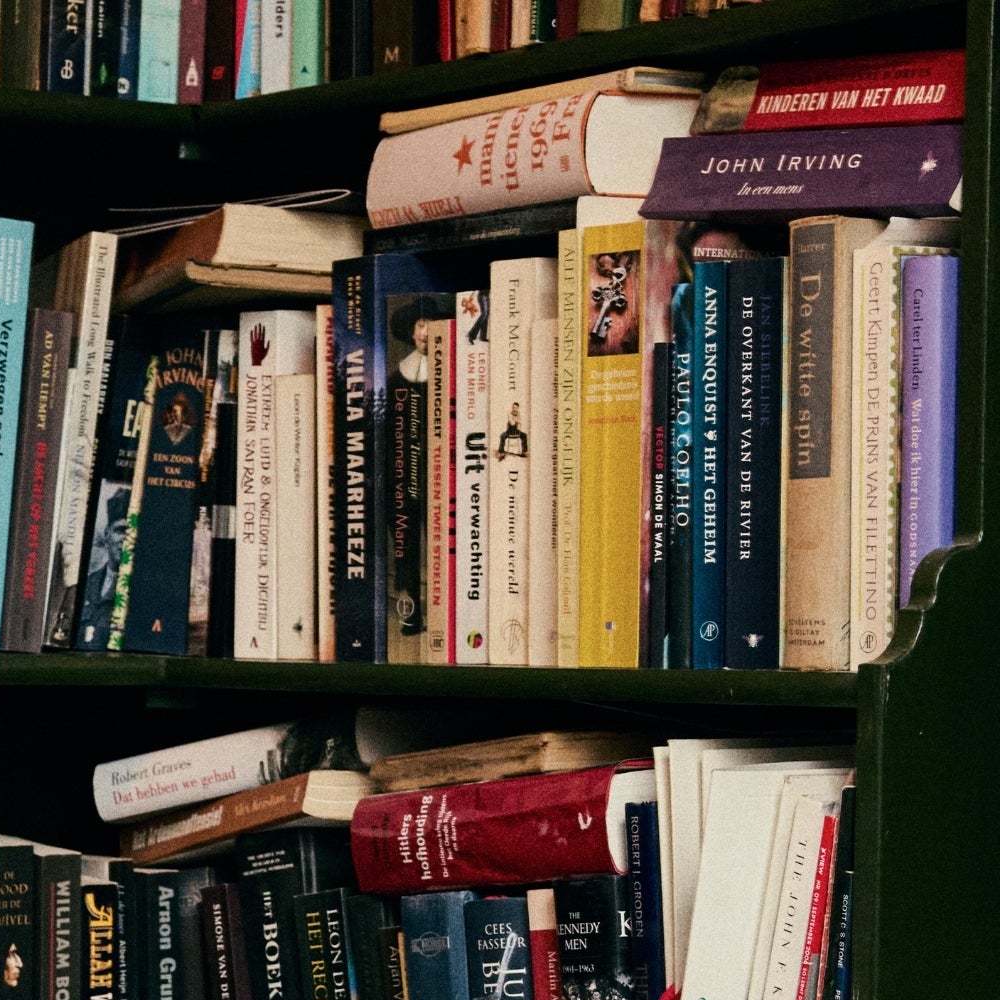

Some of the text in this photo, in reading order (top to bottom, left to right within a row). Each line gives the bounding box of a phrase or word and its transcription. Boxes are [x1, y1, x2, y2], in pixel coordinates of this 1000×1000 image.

[756, 84, 946, 114] KINDEREN VAN HET KWAAD
[701, 154, 862, 174] JOHN IRVING
[752, 183, 805, 195] een mens
[42, 353, 51, 378] VAN
[44, 331, 53, 348] AD
[477, 352, 486, 393] LEONIE
[508, 278, 519, 391] Frank McCourt
[794, 270, 821, 465] De witte spin
[703, 285, 717, 564] ANNA ENQUIST HET GEHEIM
[740, 297, 753, 560] DE OVERKANT VAN DE RIVIER
[910, 289, 923, 494] Carel ter Linden Wat hier
[346, 349, 364, 579] VILLA MAARHEEZE
[394, 388, 408, 557] De van Maria
[676, 353, 690, 527] PAULO COELHO
[865, 262, 882, 620] Geert Kimpen DE PRINS VAN FILETTINO
[432, 447, 442, 606] TUSSEN TWEE STOELEN
[465, 433, 486, 600] Uit verwachting
[508, 470, 518, 594] De nieuwe wereld
[654, 426, 664, 562] VECTOR SIMON DE WAAL
[110, 759, 192, 786] Robert Graves
[398, 814, 413, 863] Hitlers
[415, 795, 433, 880] hofhouding
[631, 815, 644, 938] ROBERT GRODEN
[56, 880, 70, 969] WILLIAM
[85, 893, 113, 989] ALLAH
[157, 886, 174, 950] Arnon
[212, 903, 227, 980] SIMONE VAN
[306, 912, 323, 953] HET
[326, 908, 342, 964] LEON
[478, 936, 526, 951] FASSEUR
[484, 923, 512, 936] CEES
[564, 939, 588, 951] MEN
[569, 911, 581, 920] THE
[262, 922, 283, 998] BOEK
[332, 971, 346, 1000] DE
[547, 951, 558, 995] Martin
